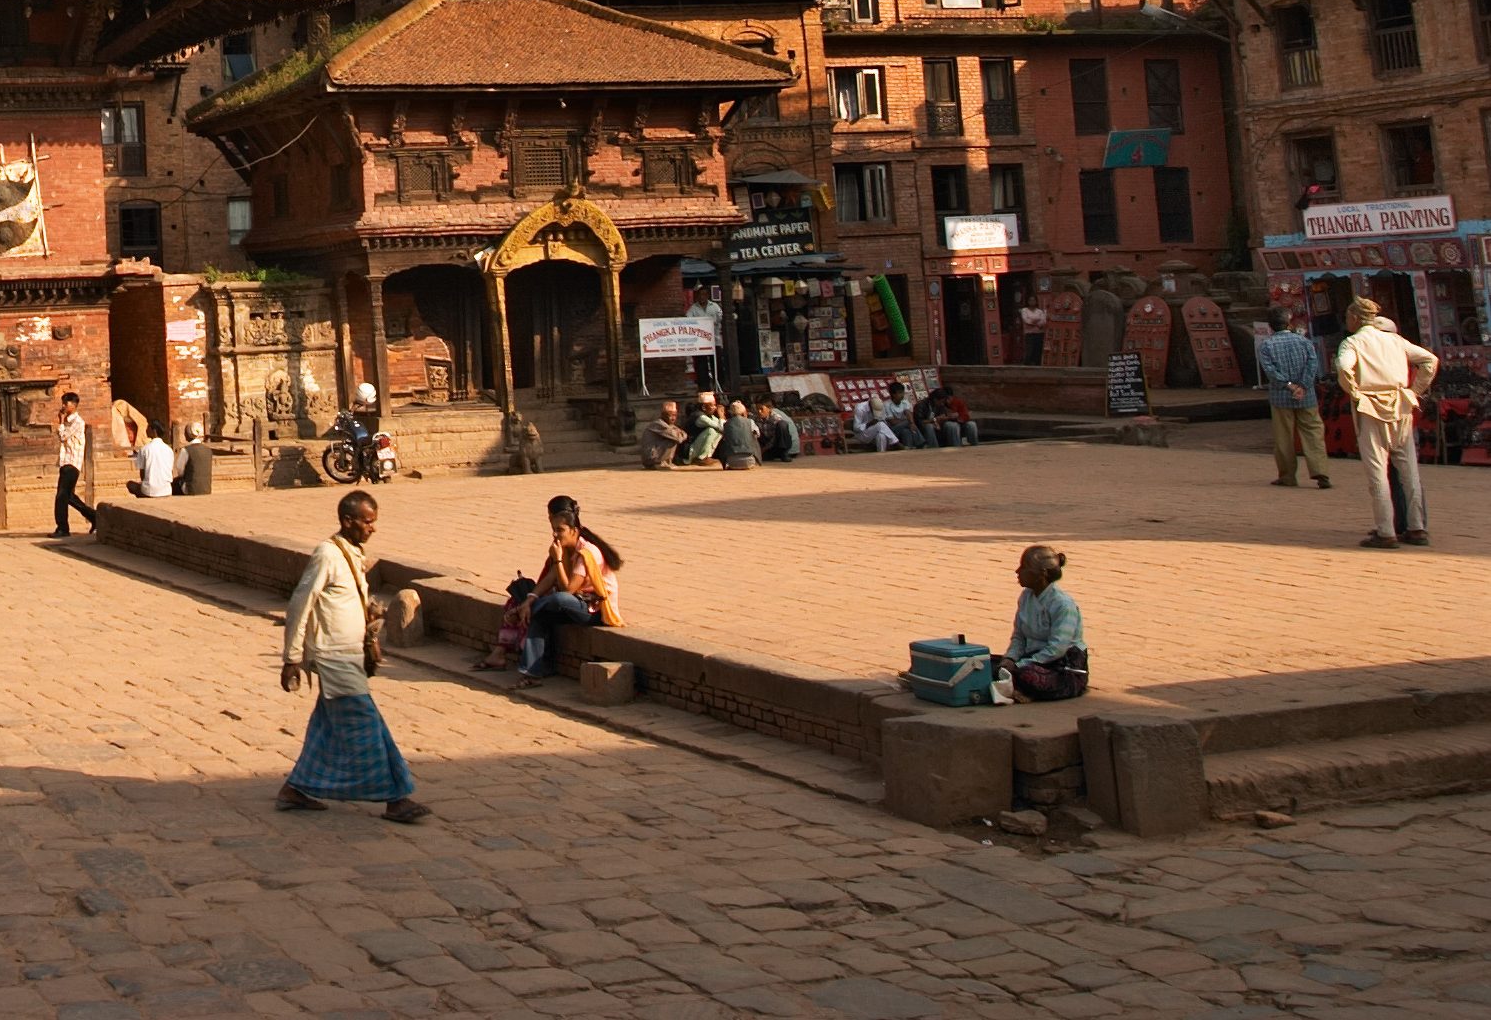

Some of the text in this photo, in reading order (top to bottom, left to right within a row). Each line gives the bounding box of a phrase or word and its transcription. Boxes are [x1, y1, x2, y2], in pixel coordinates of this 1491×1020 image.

[731, 221, 812, 240] ANDMADE PAPER
[1308, 207, 1451, 236] THANGKA PAINTING
[739, 247, 761, 260] TEA
[761, 242, 803, 257] CENTER
[678, 325, 713, 341] PAINTING
